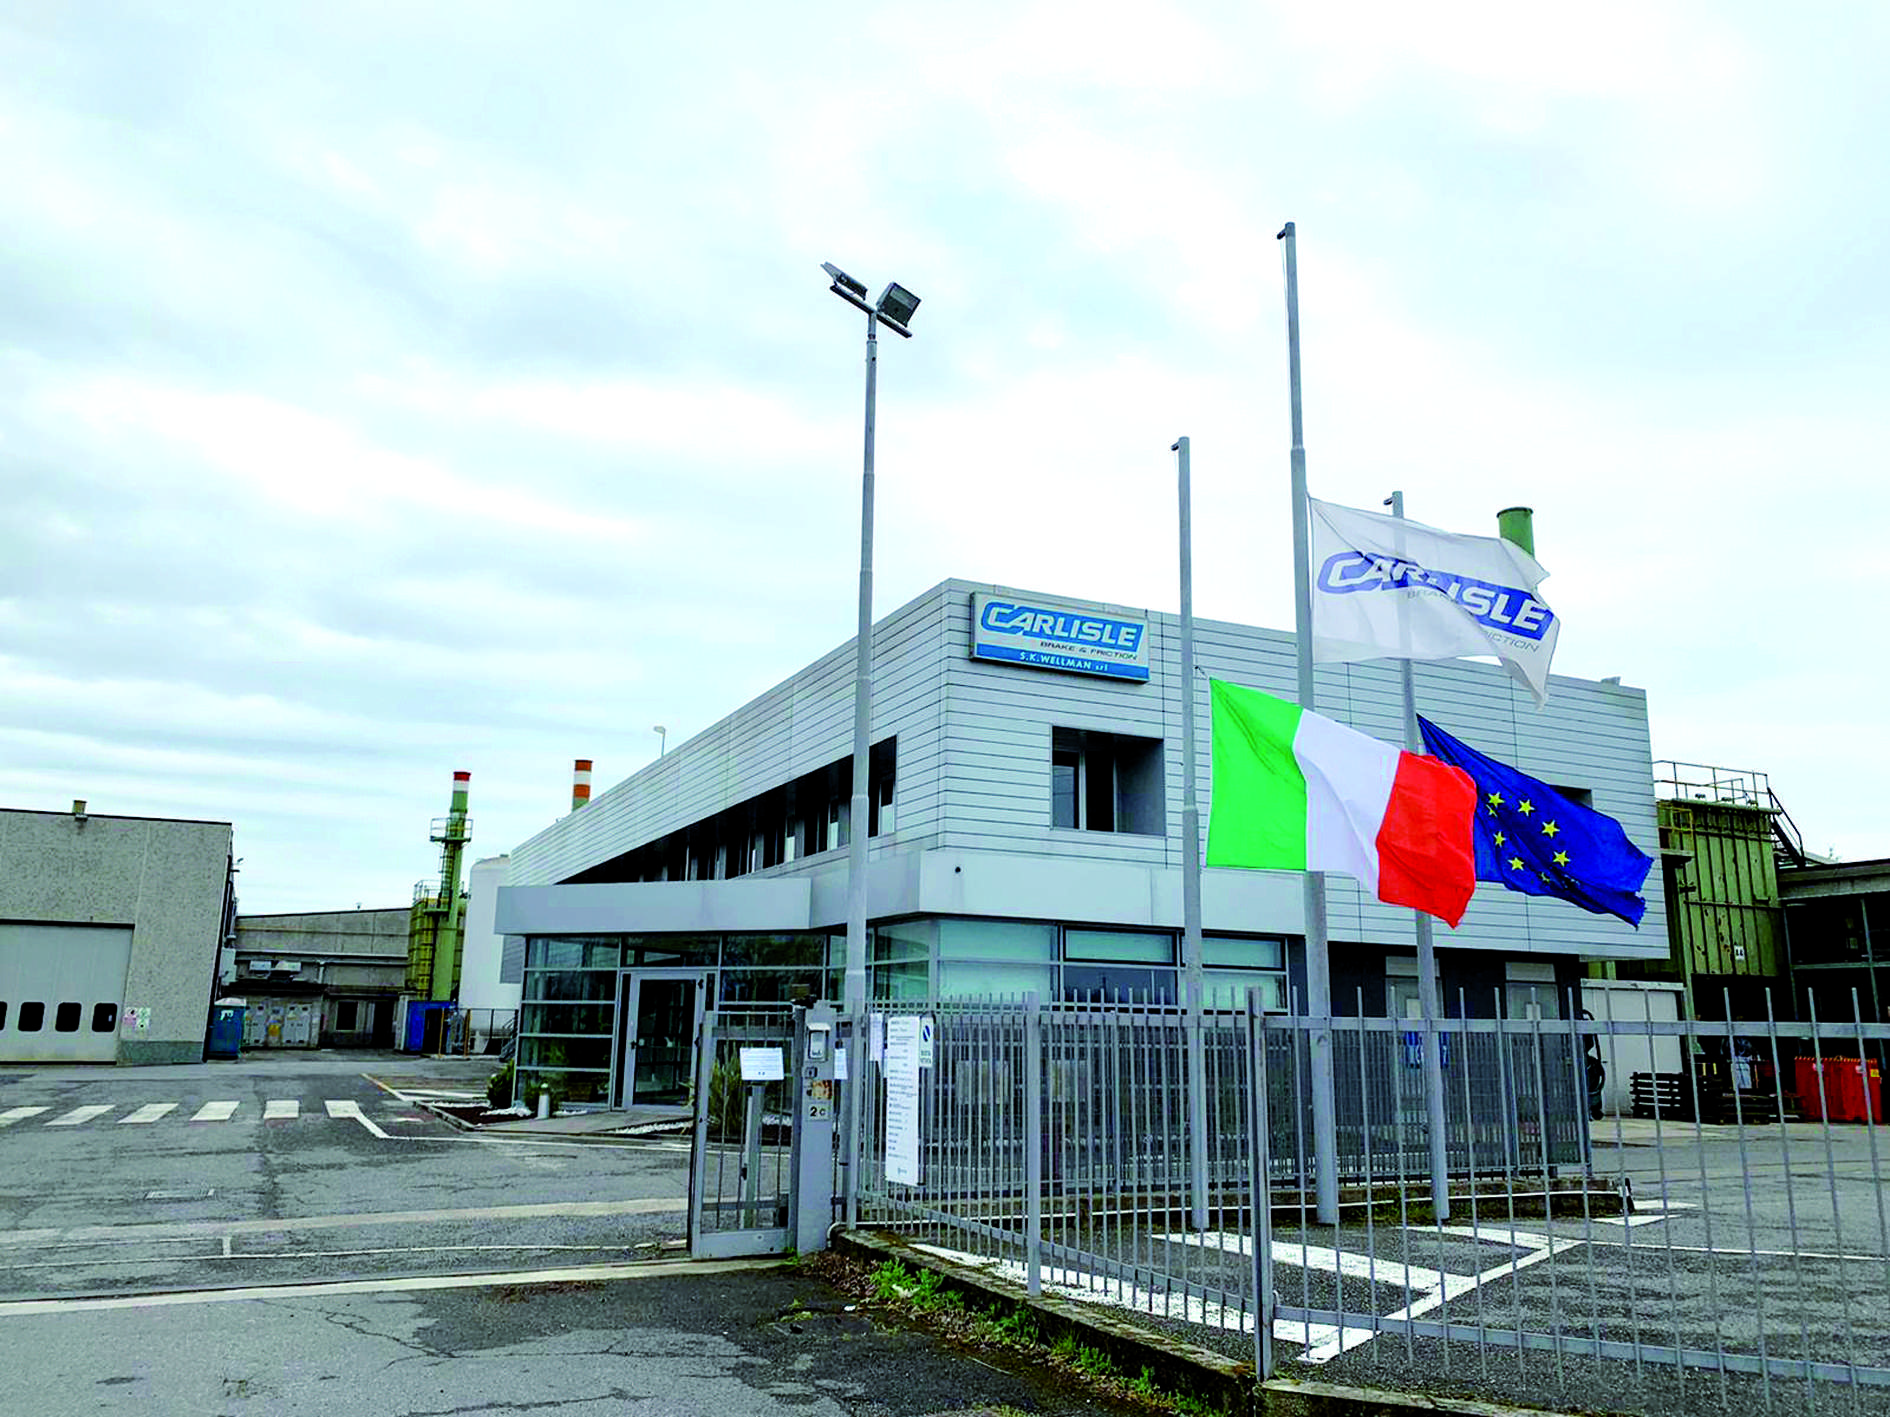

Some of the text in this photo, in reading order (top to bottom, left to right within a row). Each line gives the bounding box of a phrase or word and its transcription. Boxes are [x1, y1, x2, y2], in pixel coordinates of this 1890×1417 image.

[1326, 555, 1550, 632] CARISLE
[986, 605, 1138, 648] CARLISLE
[1487, 631, 1540, 652] ICTION
[1040, 641, 1138, 661] BRAKE & FRICTION
